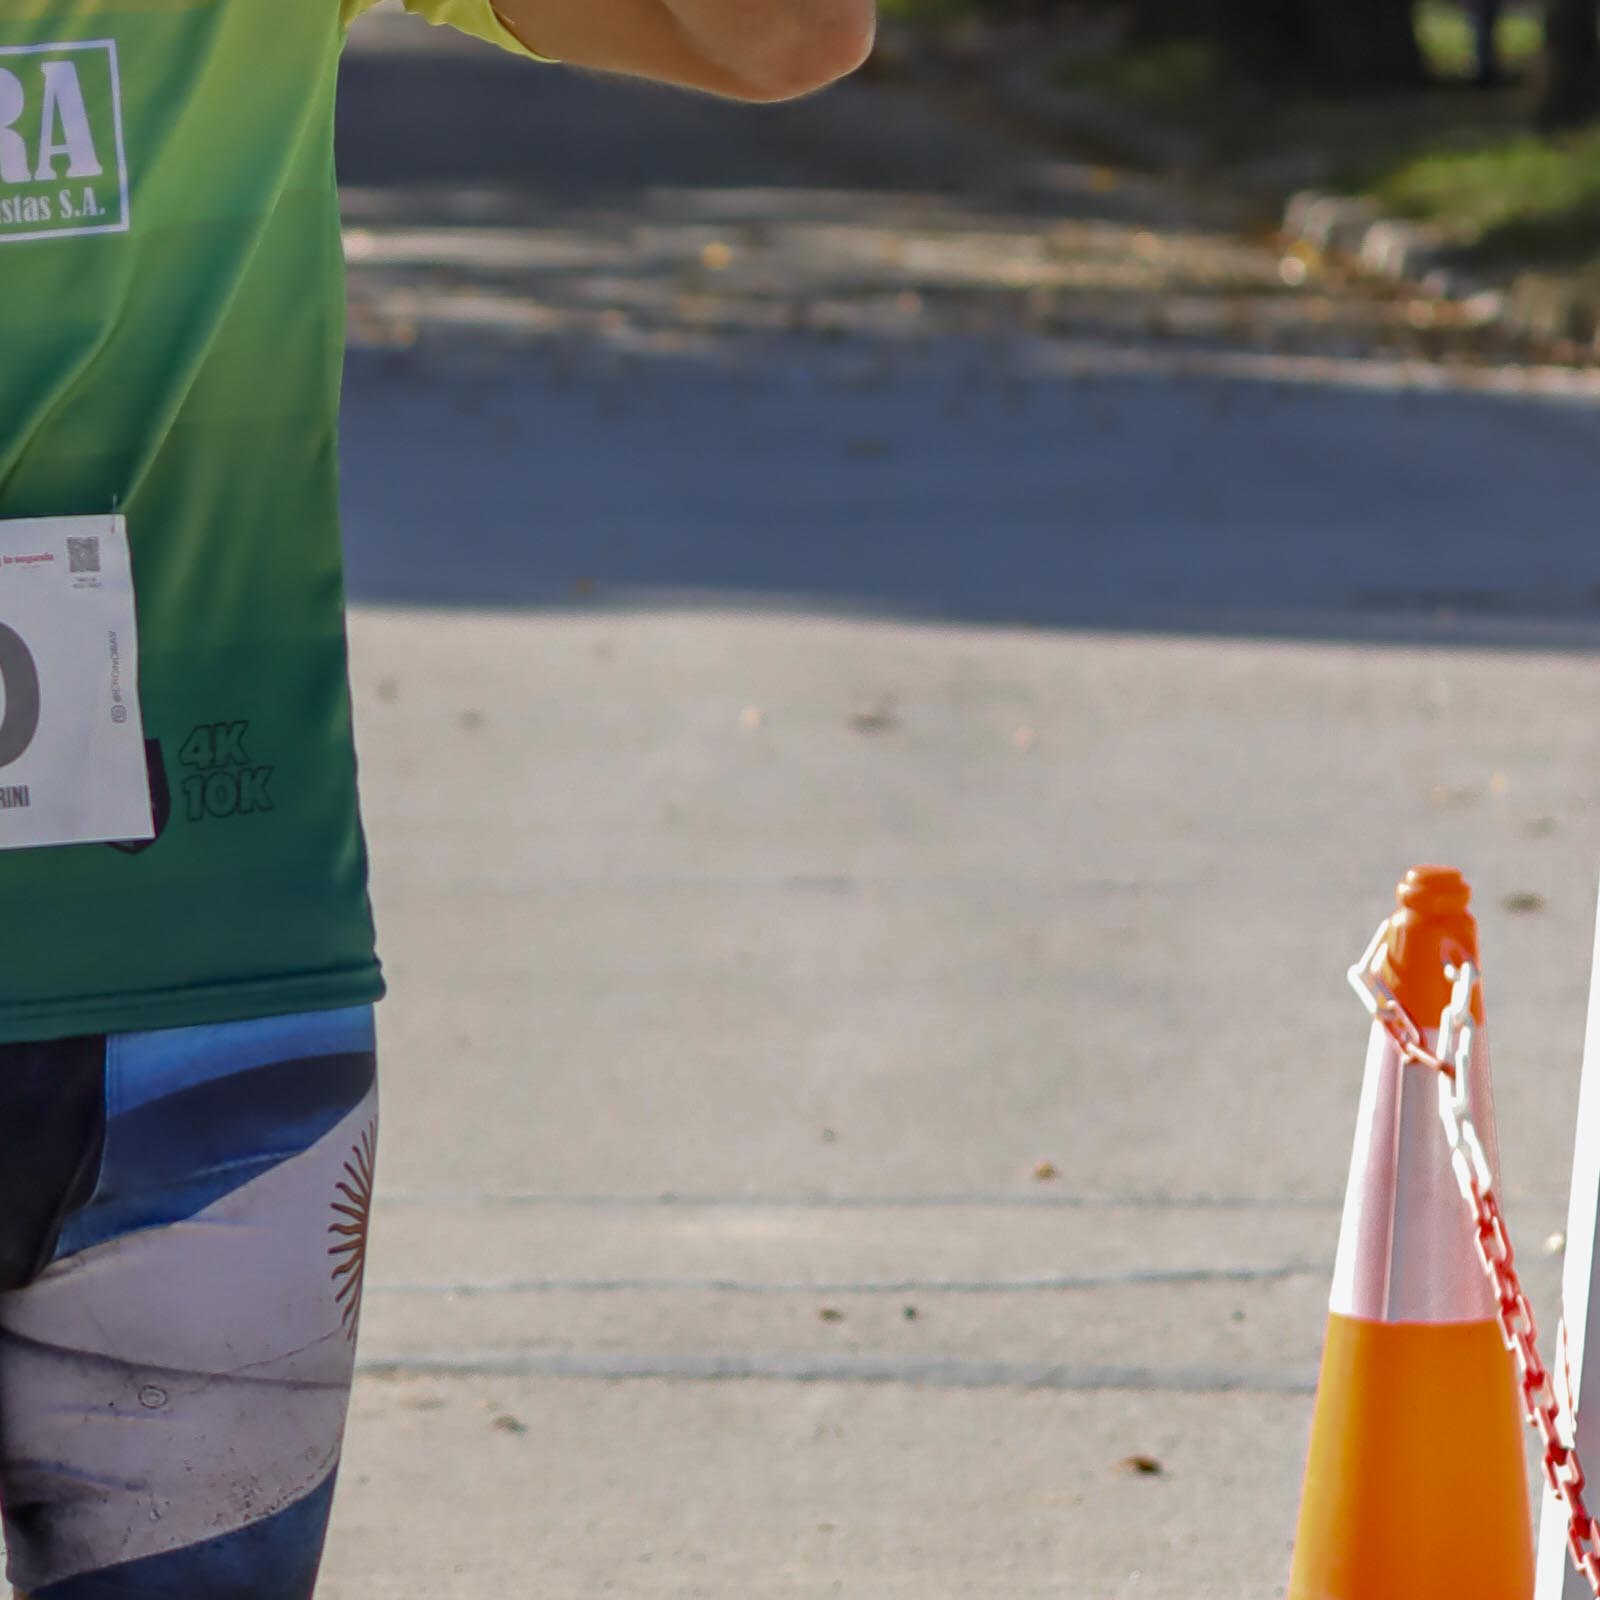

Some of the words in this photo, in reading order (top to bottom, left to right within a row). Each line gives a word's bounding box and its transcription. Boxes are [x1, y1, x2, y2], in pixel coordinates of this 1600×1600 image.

[58, 186, 107, 218] S.A.
[179, 720, 250, 770] 4K
[182, 766, 275, 822] 10K
